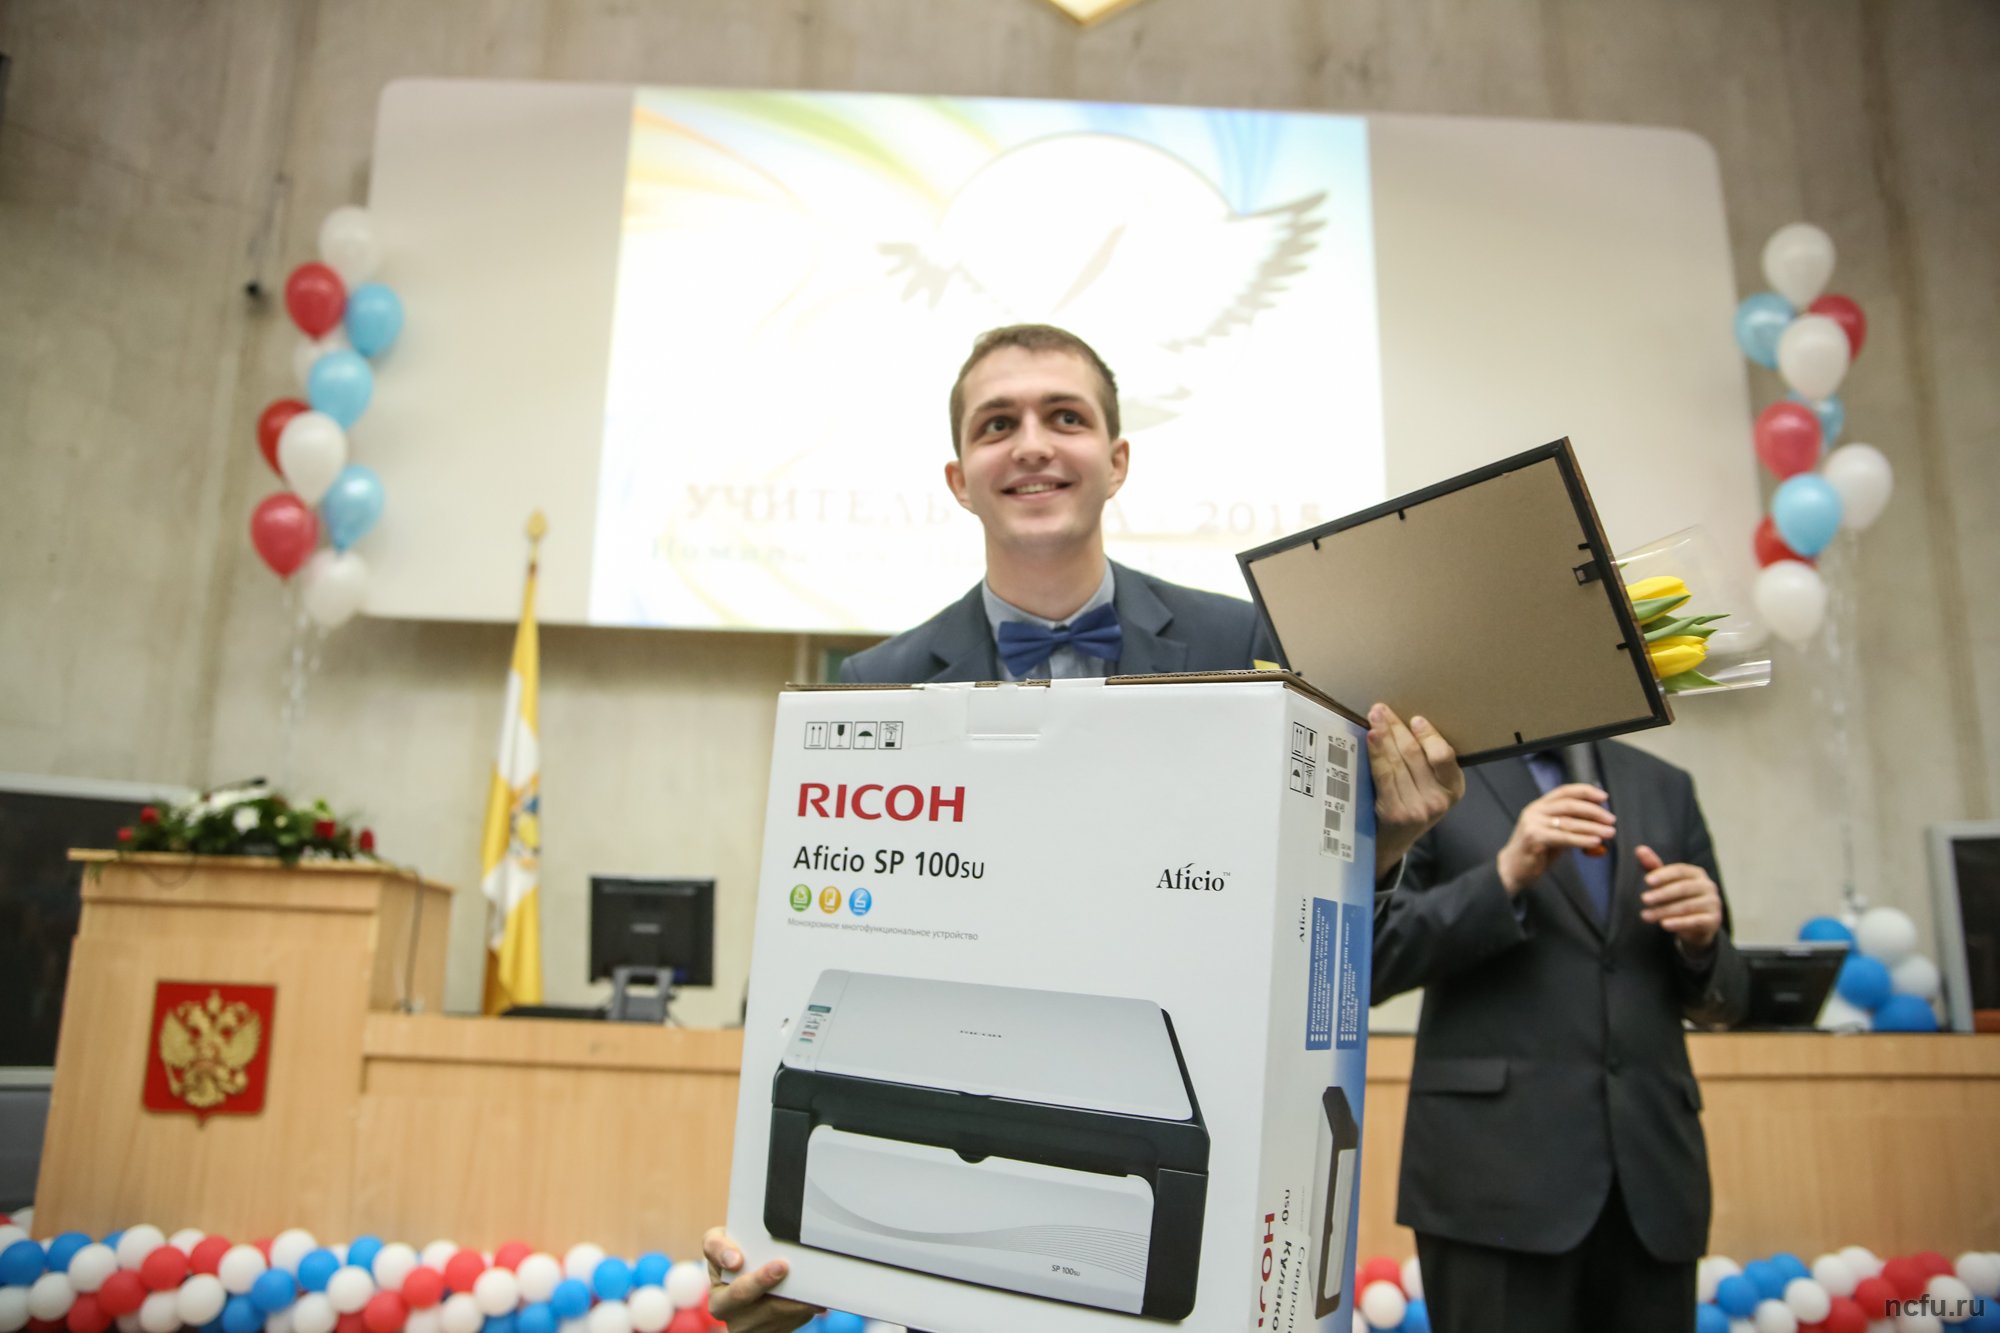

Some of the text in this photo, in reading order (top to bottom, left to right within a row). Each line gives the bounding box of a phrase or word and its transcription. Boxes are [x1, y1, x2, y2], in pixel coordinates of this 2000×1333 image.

[797, 783, 966, 822] RICOH
[793, 845, 865, 872] Aficio
[874, 849, 904, 874] SP
[787, 917, 980, 942] Монохромное многофункциональное устройство
